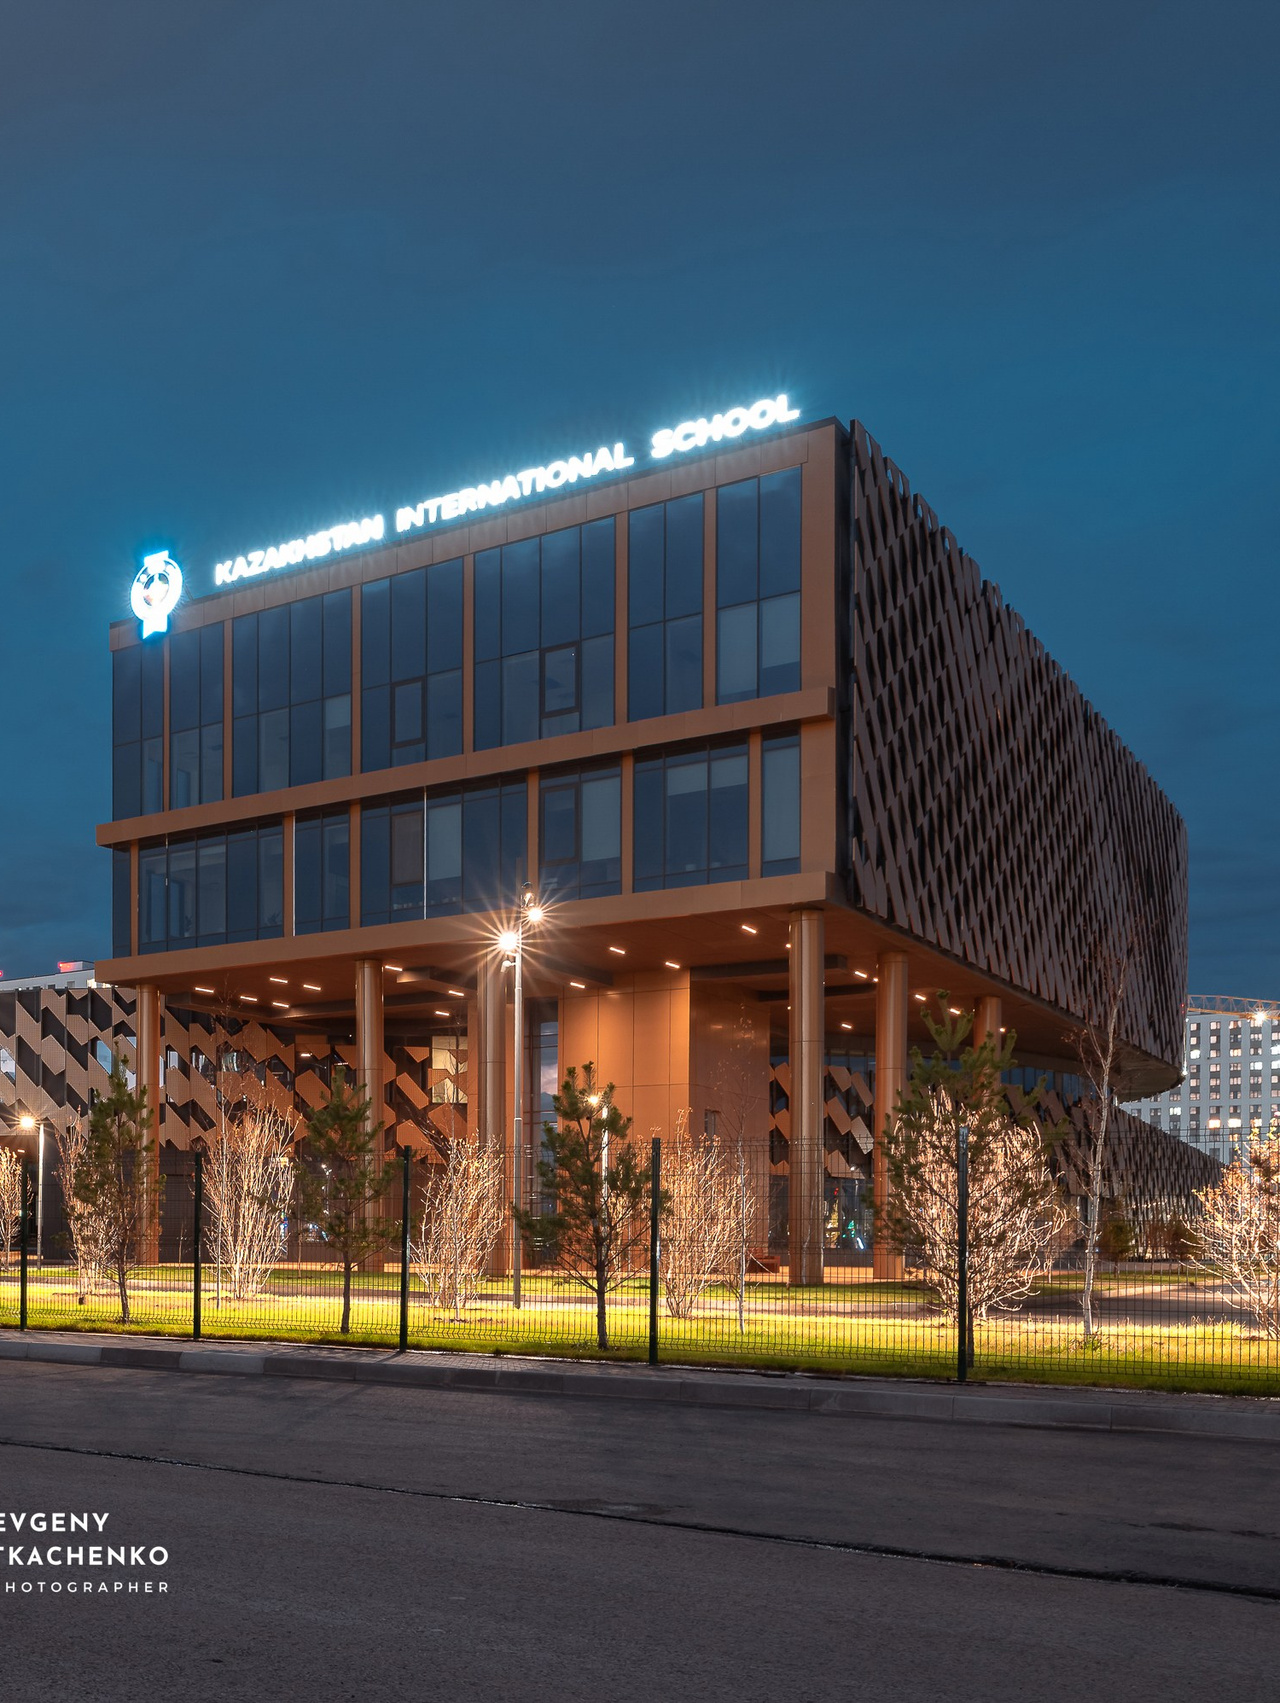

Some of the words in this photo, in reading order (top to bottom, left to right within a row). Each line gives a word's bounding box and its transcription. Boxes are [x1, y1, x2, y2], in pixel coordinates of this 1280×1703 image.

[215, 514, 385, 586] KAZAKHSTAN
[396, 442, 635, 533] INTERNATIONAL
[650, 394, 800, 459] SCHOOL
